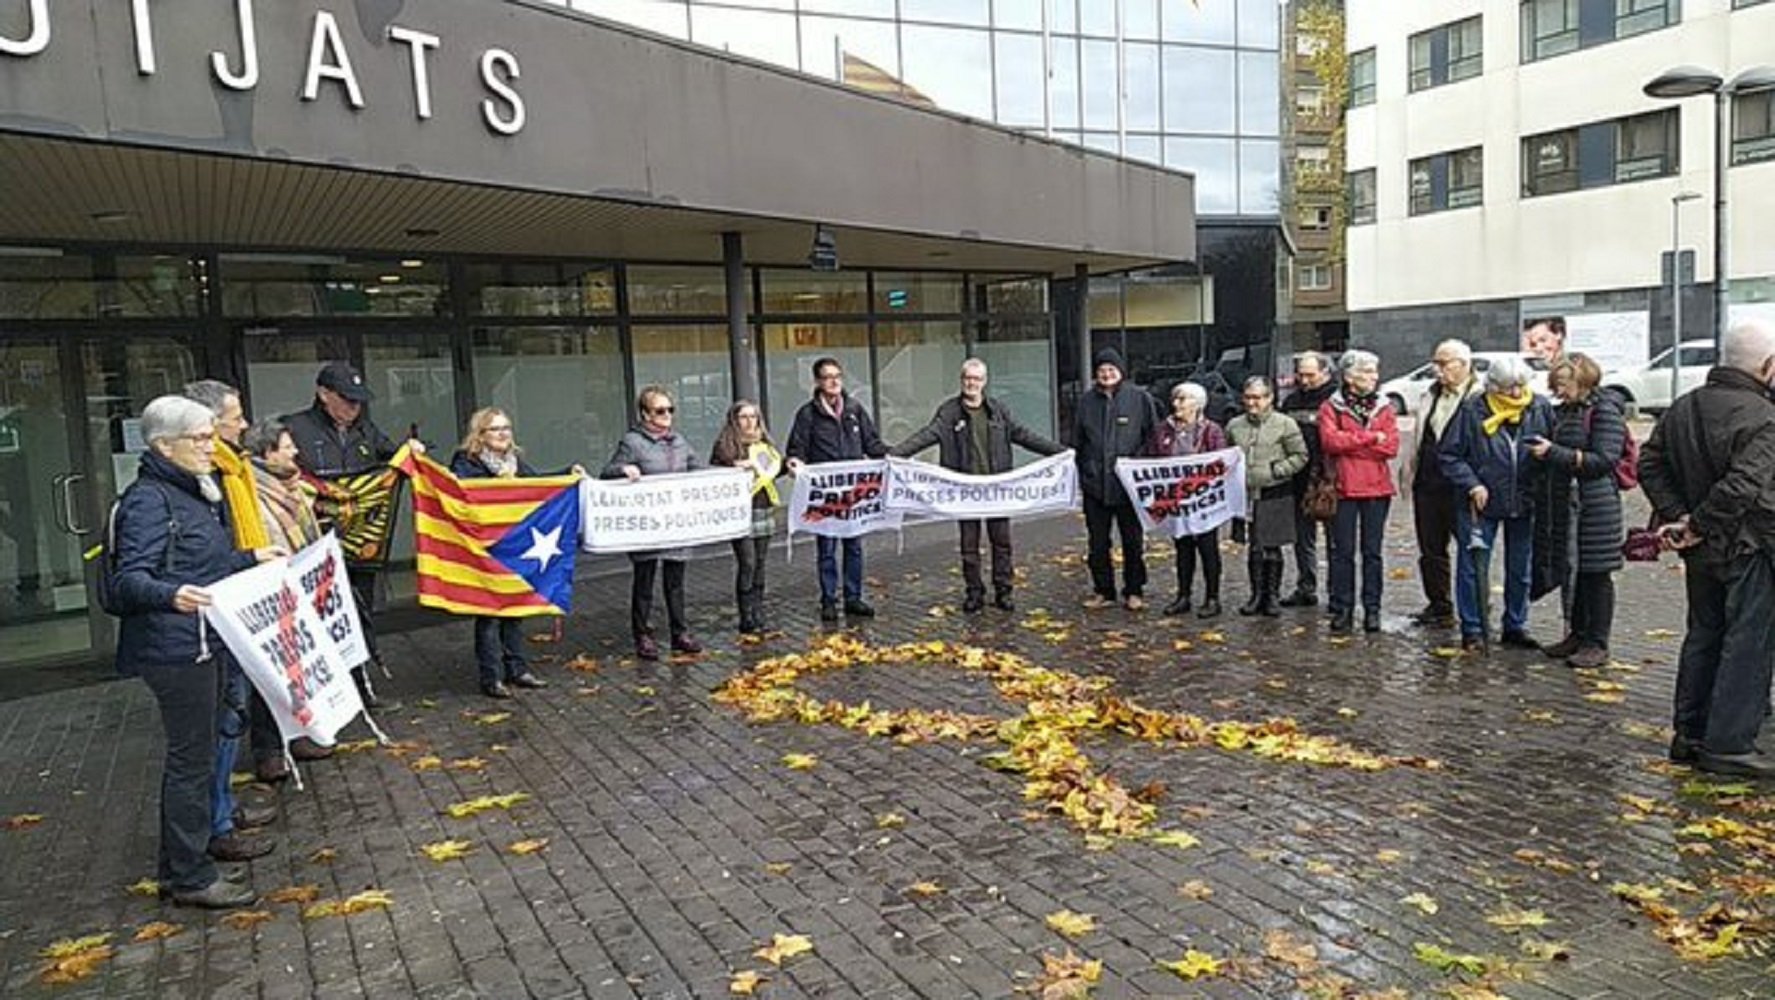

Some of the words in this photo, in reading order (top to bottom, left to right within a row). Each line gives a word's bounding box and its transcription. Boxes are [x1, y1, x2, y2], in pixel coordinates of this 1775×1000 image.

[682, 482, 740, 501] PRESOS
[893, 486, 956, 504] PRESES
[593, 515, 661, 534] PRESES
